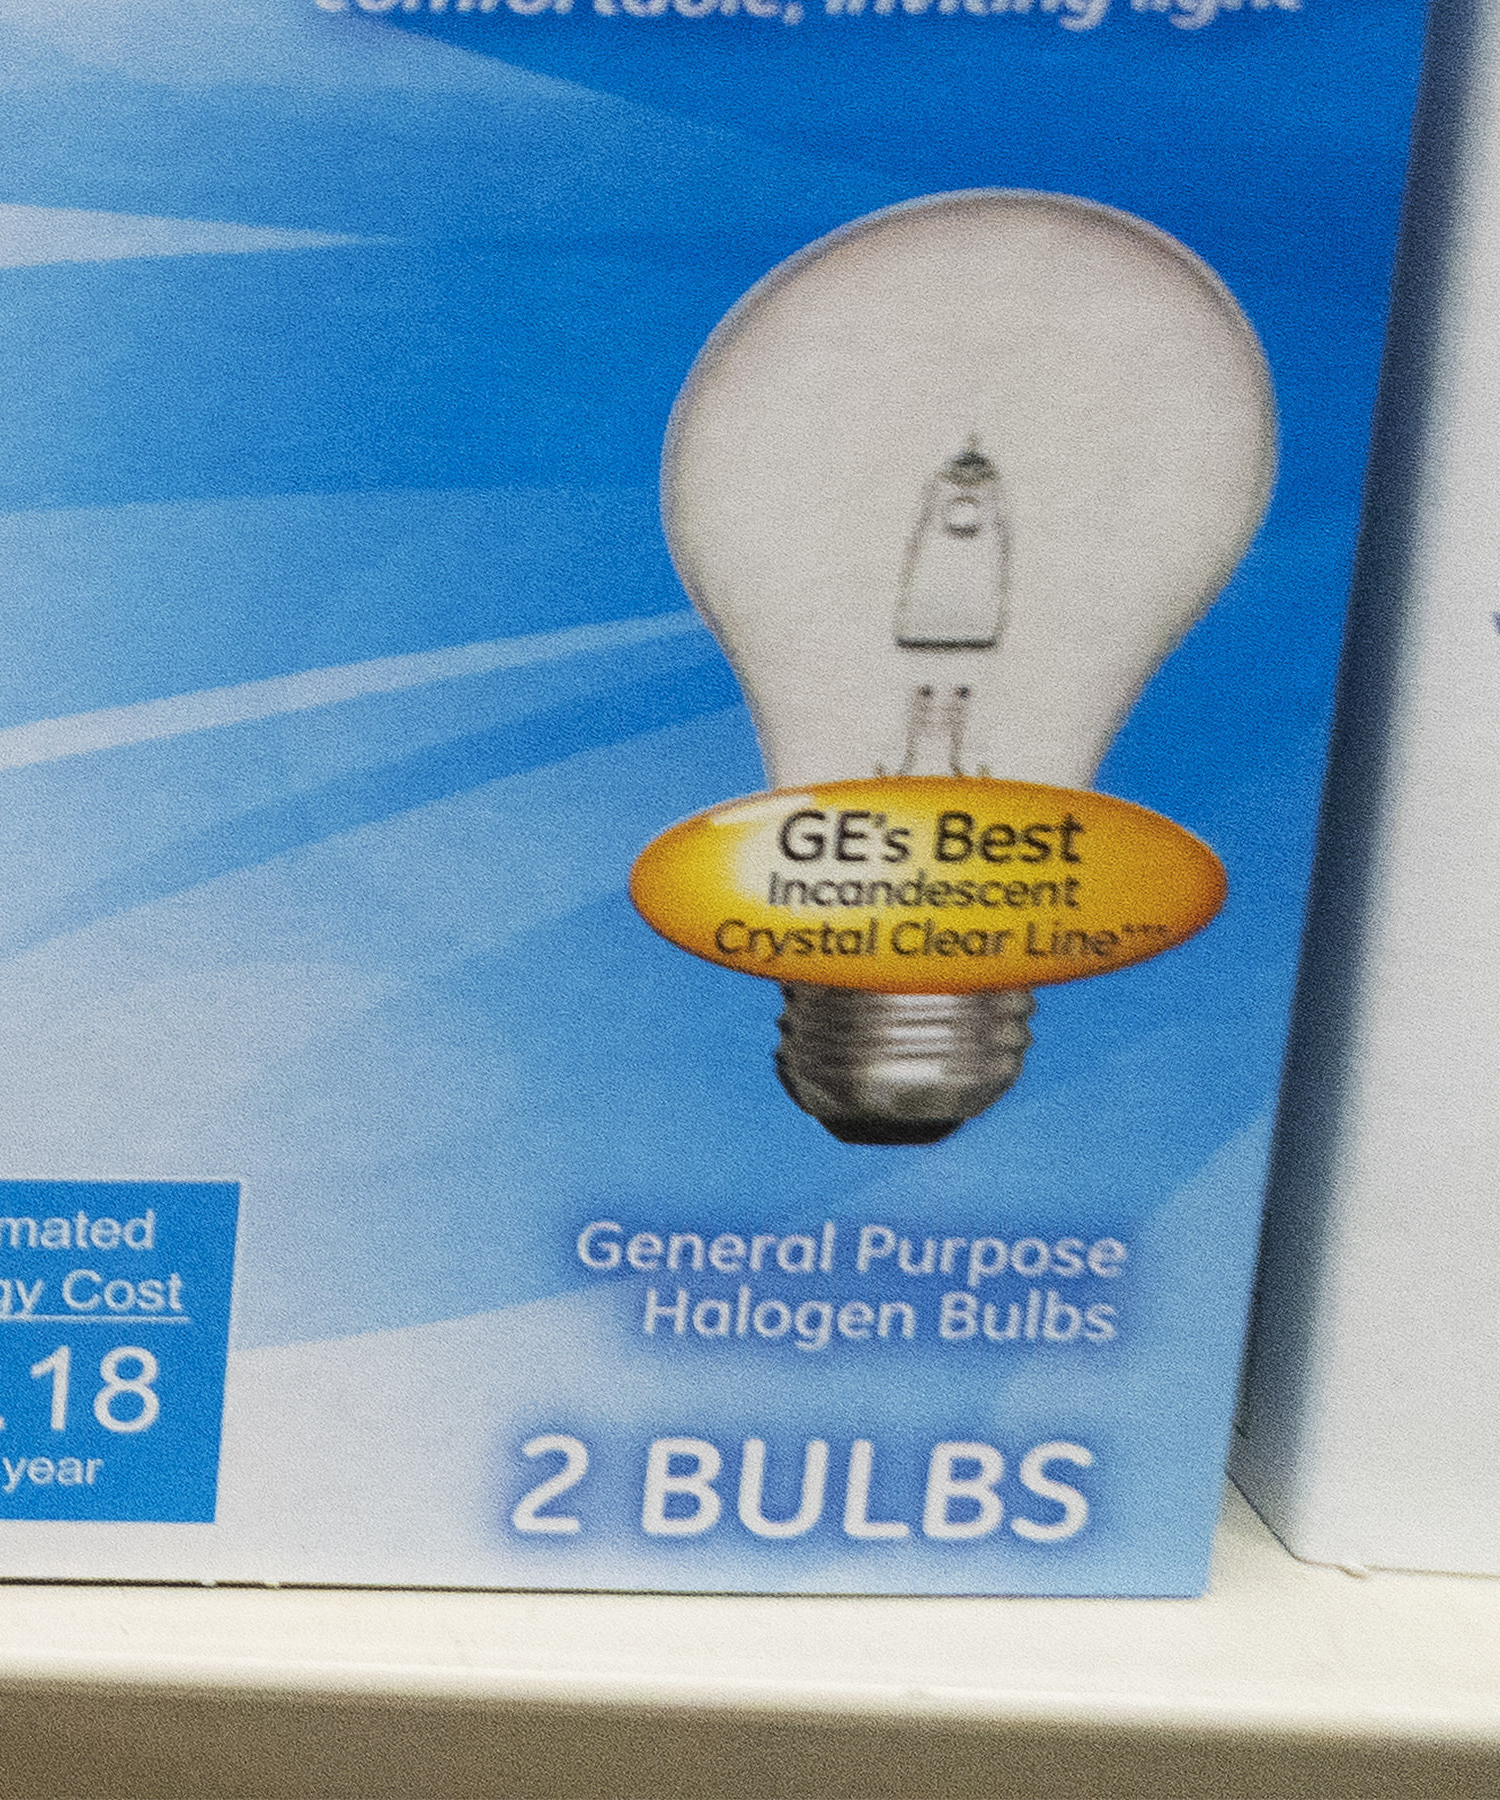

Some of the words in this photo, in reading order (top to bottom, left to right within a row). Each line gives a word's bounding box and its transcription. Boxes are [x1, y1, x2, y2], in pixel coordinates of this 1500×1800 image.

[779, 812, 909, 865] GE's
[933, 812, 1083, 864] Best
[768, 872, 1080, 909] Incandescent
[714, 919, 879, 962] Crystal
[890, 921, 1004, 957] Clear
[576, 1221, 835, 1275] General
[857, 1224, 1128, 1284] Purpose
[61, 1268, 183, 1312] Cost
[643, 1287, 916, 1348] Halogen
[939, 1292, 1116, 1342] Bulbs
[3, 1451, 102, 1492] year
[513, 1434, 587, 1536] 2
[644, 1439, 1094, 1541] BULBS
